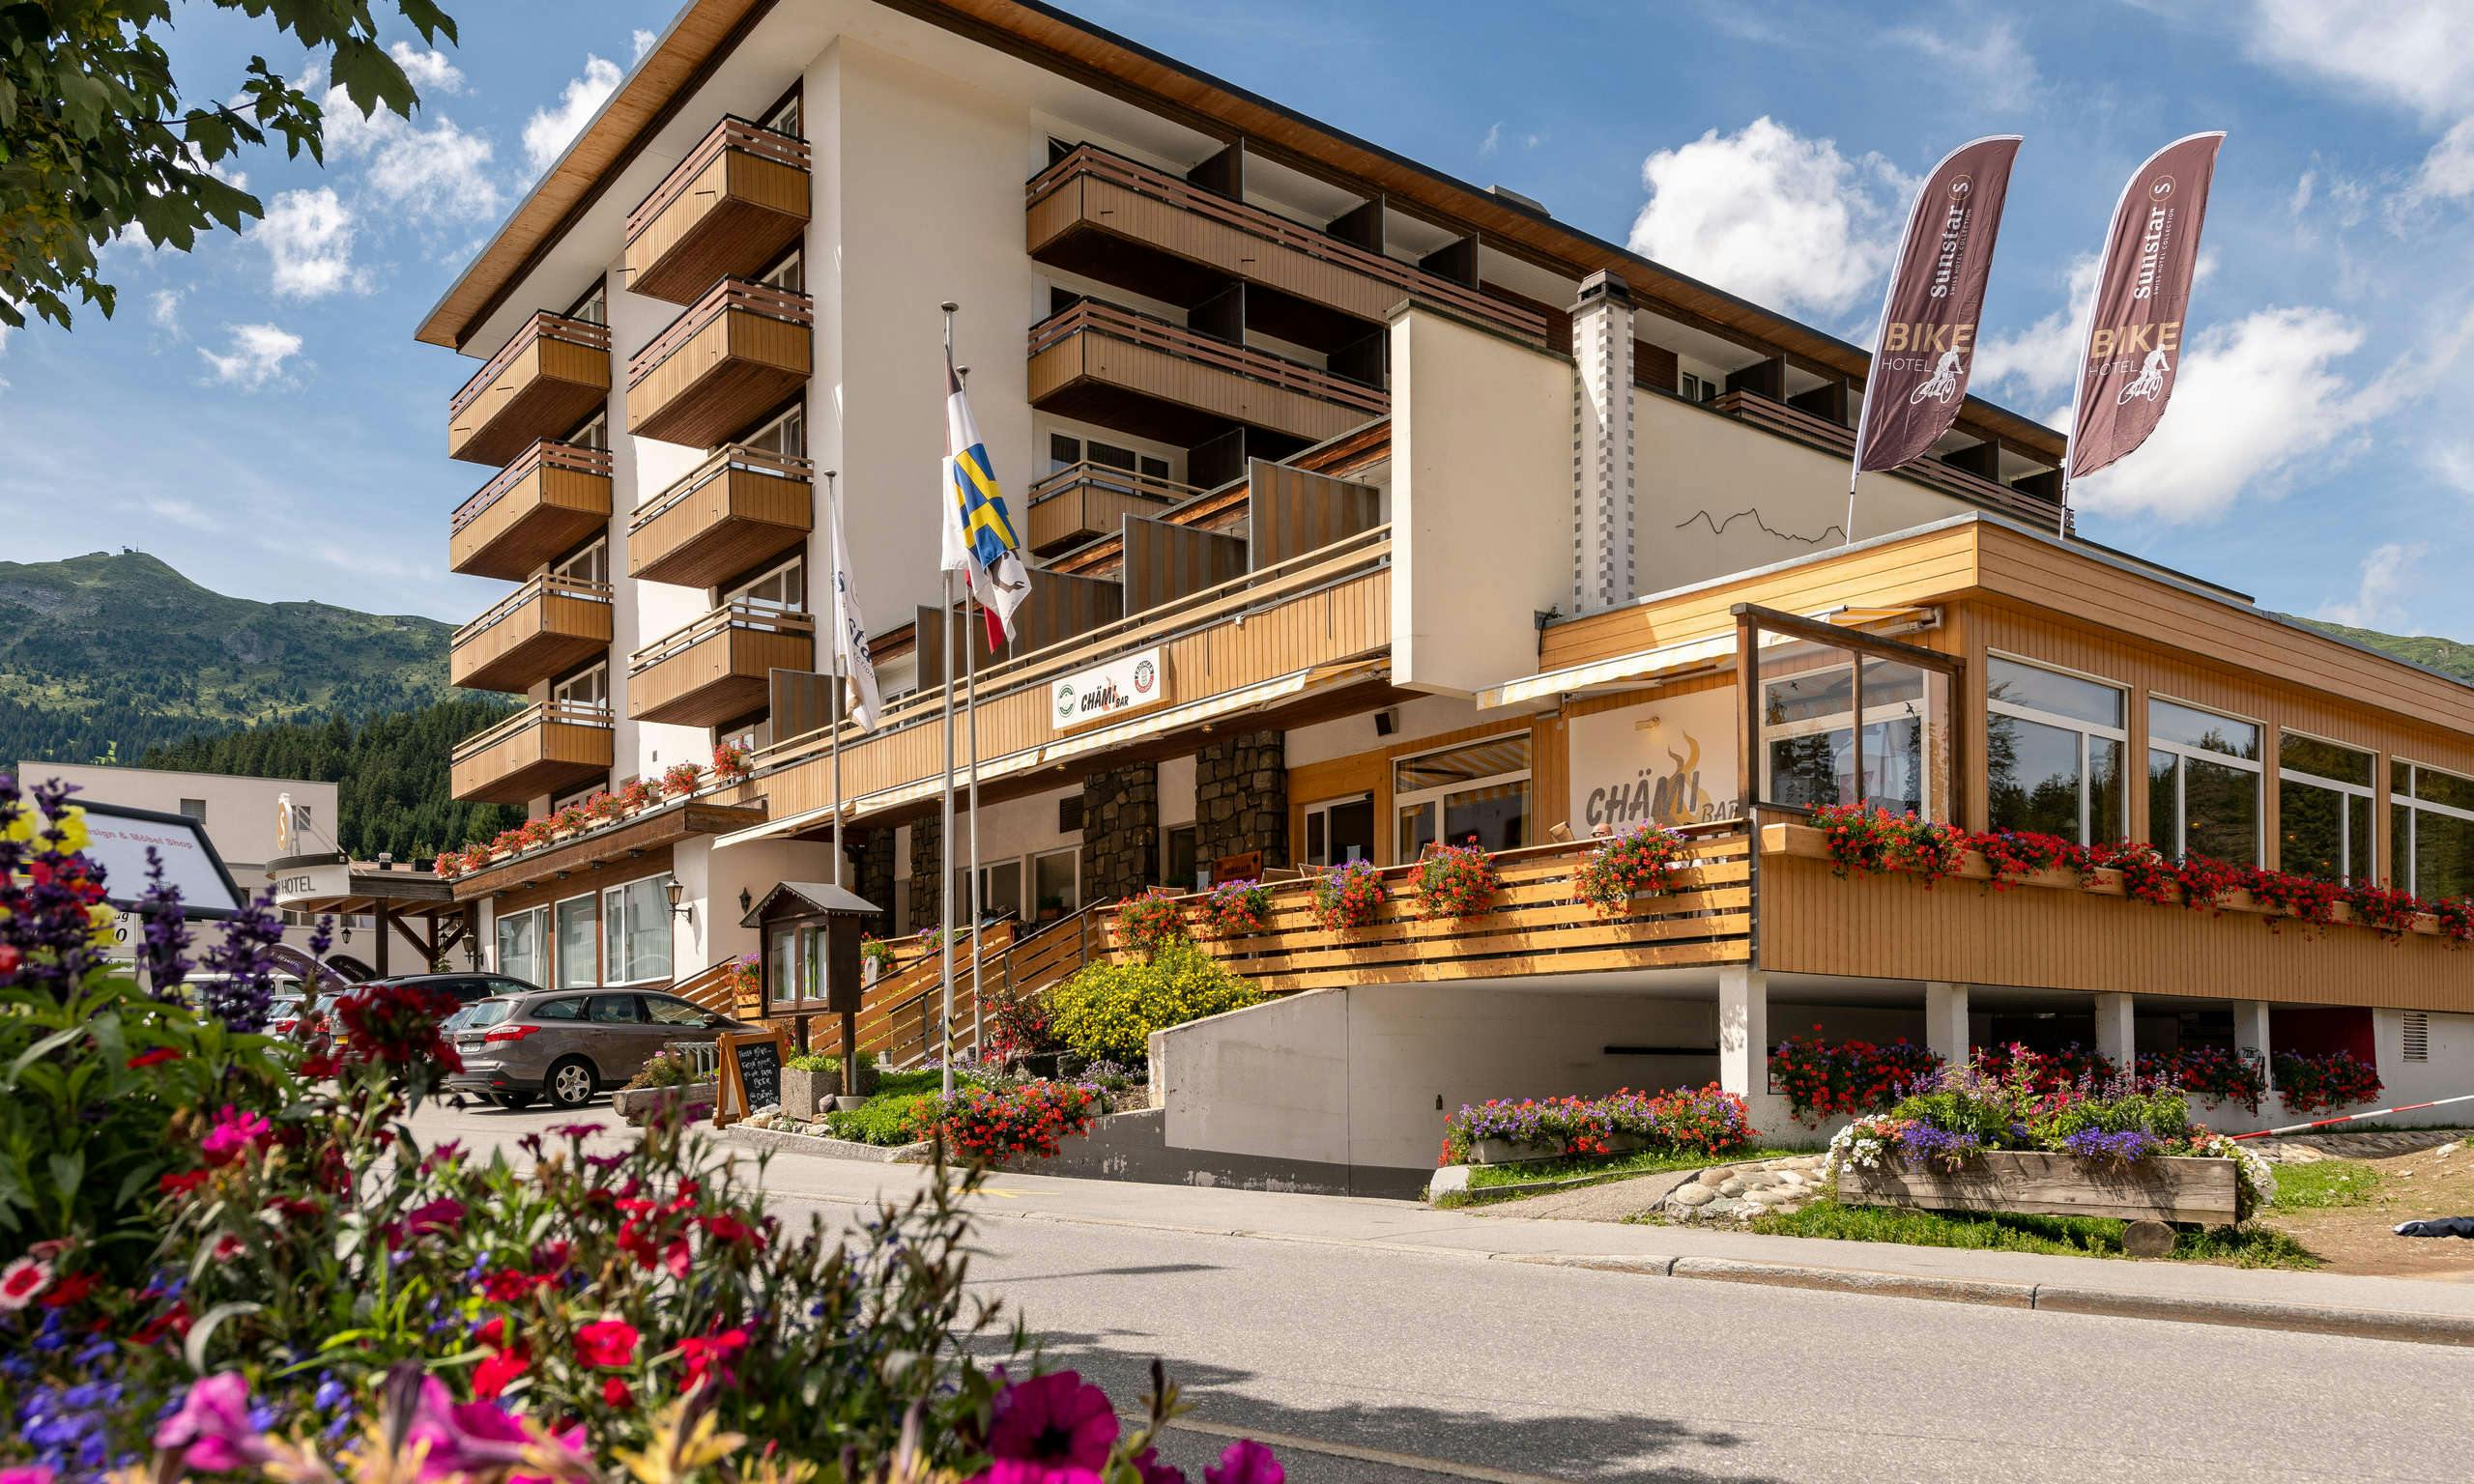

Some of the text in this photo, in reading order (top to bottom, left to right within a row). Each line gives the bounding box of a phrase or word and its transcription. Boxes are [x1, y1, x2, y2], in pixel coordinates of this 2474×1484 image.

[1930, 205, 1964, 299] Sunstar
[1949, 209, 1972, 296] SWISS HOTEL COLLECTION
[2134, 207, 2167, 300] Sunstar
[2153, 274, 2162, 295] SWISS
[2162, 208, 2175, 250] COLLECTION
[1884, 322, 1974, 353] BIKE
[2090, 322, 2180, 358] BIKE
[1881, 357, 1933, 372] HOTEL
[2088, 360, 2139, 378] HOTEL
[1080, 684, 1117, 712] CHÄMI
[1115, 695, 1129, 709] BAR
[1585, 767, 1700, 827] CHÄMI
[282, 874, 316, 895] HOTEL
